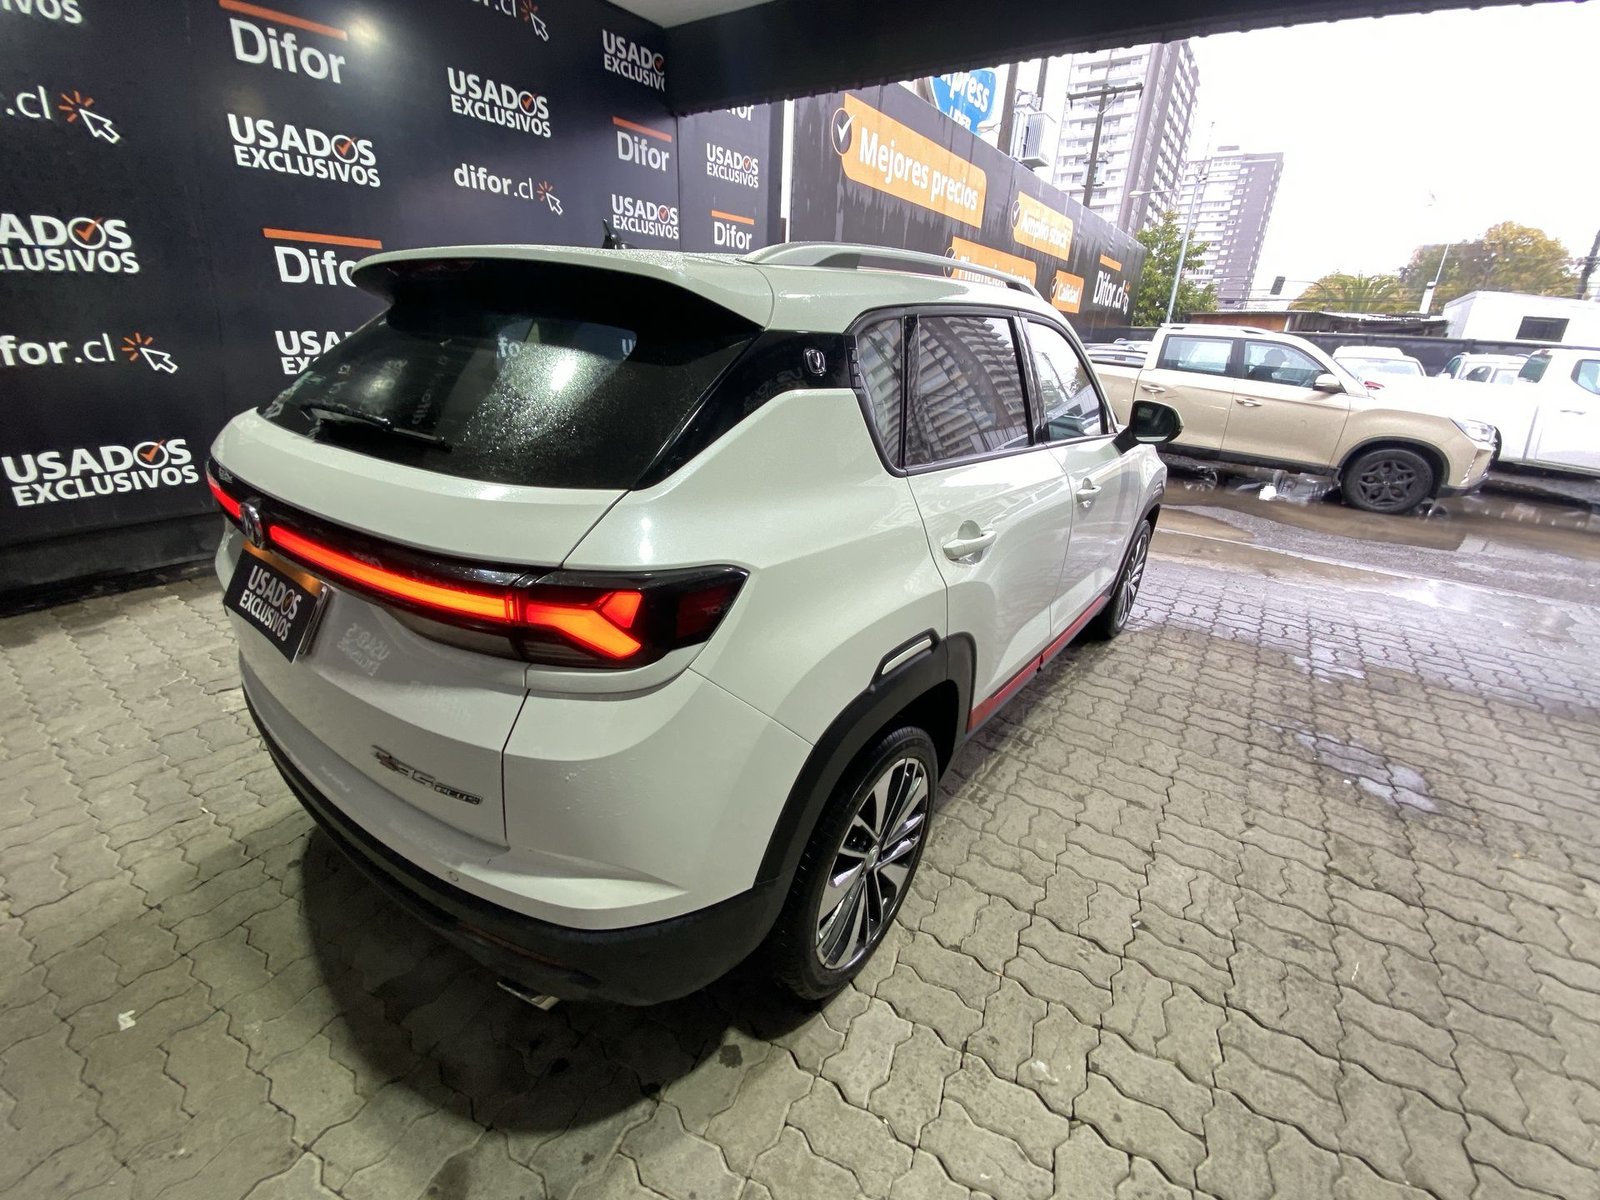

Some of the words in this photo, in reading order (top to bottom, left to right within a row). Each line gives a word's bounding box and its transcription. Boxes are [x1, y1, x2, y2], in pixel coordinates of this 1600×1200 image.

[229, 17, 346, 84] Difor
[447, 67, 550, 120] USADOS
[451, 94, 552, 138] EXCLUSIVOS
[227, 113, 377, 166] USADOS
[616, 130, 670, 172] Difor
[706, 142, 760, 176] USADOS
[234, 145, 381, 188] EXCLUSIVOS
[453, 163, 534, 200] difor.cl
[706, 162, 760, 189] EXCLUSIVOS
[860, 127, 929, 190] Mejores
[931, 169, 979, 211] precios
[611, 193, 679, 226] USADOS
[612, 213, 680, 241] EXCLUSIVOS
[713, 221, 753, 250] Difor
[0, 247, 140, 274] LUSIVOS
[275, 331, 353, 356] USA
[1, 438, 192, 484] USADOS
[11, 464, 199, 507] EXCLUSIVOS
[248, 565, 302, 621] USADOS
[239, 589, 292, 642] EXCLUSIVOS
